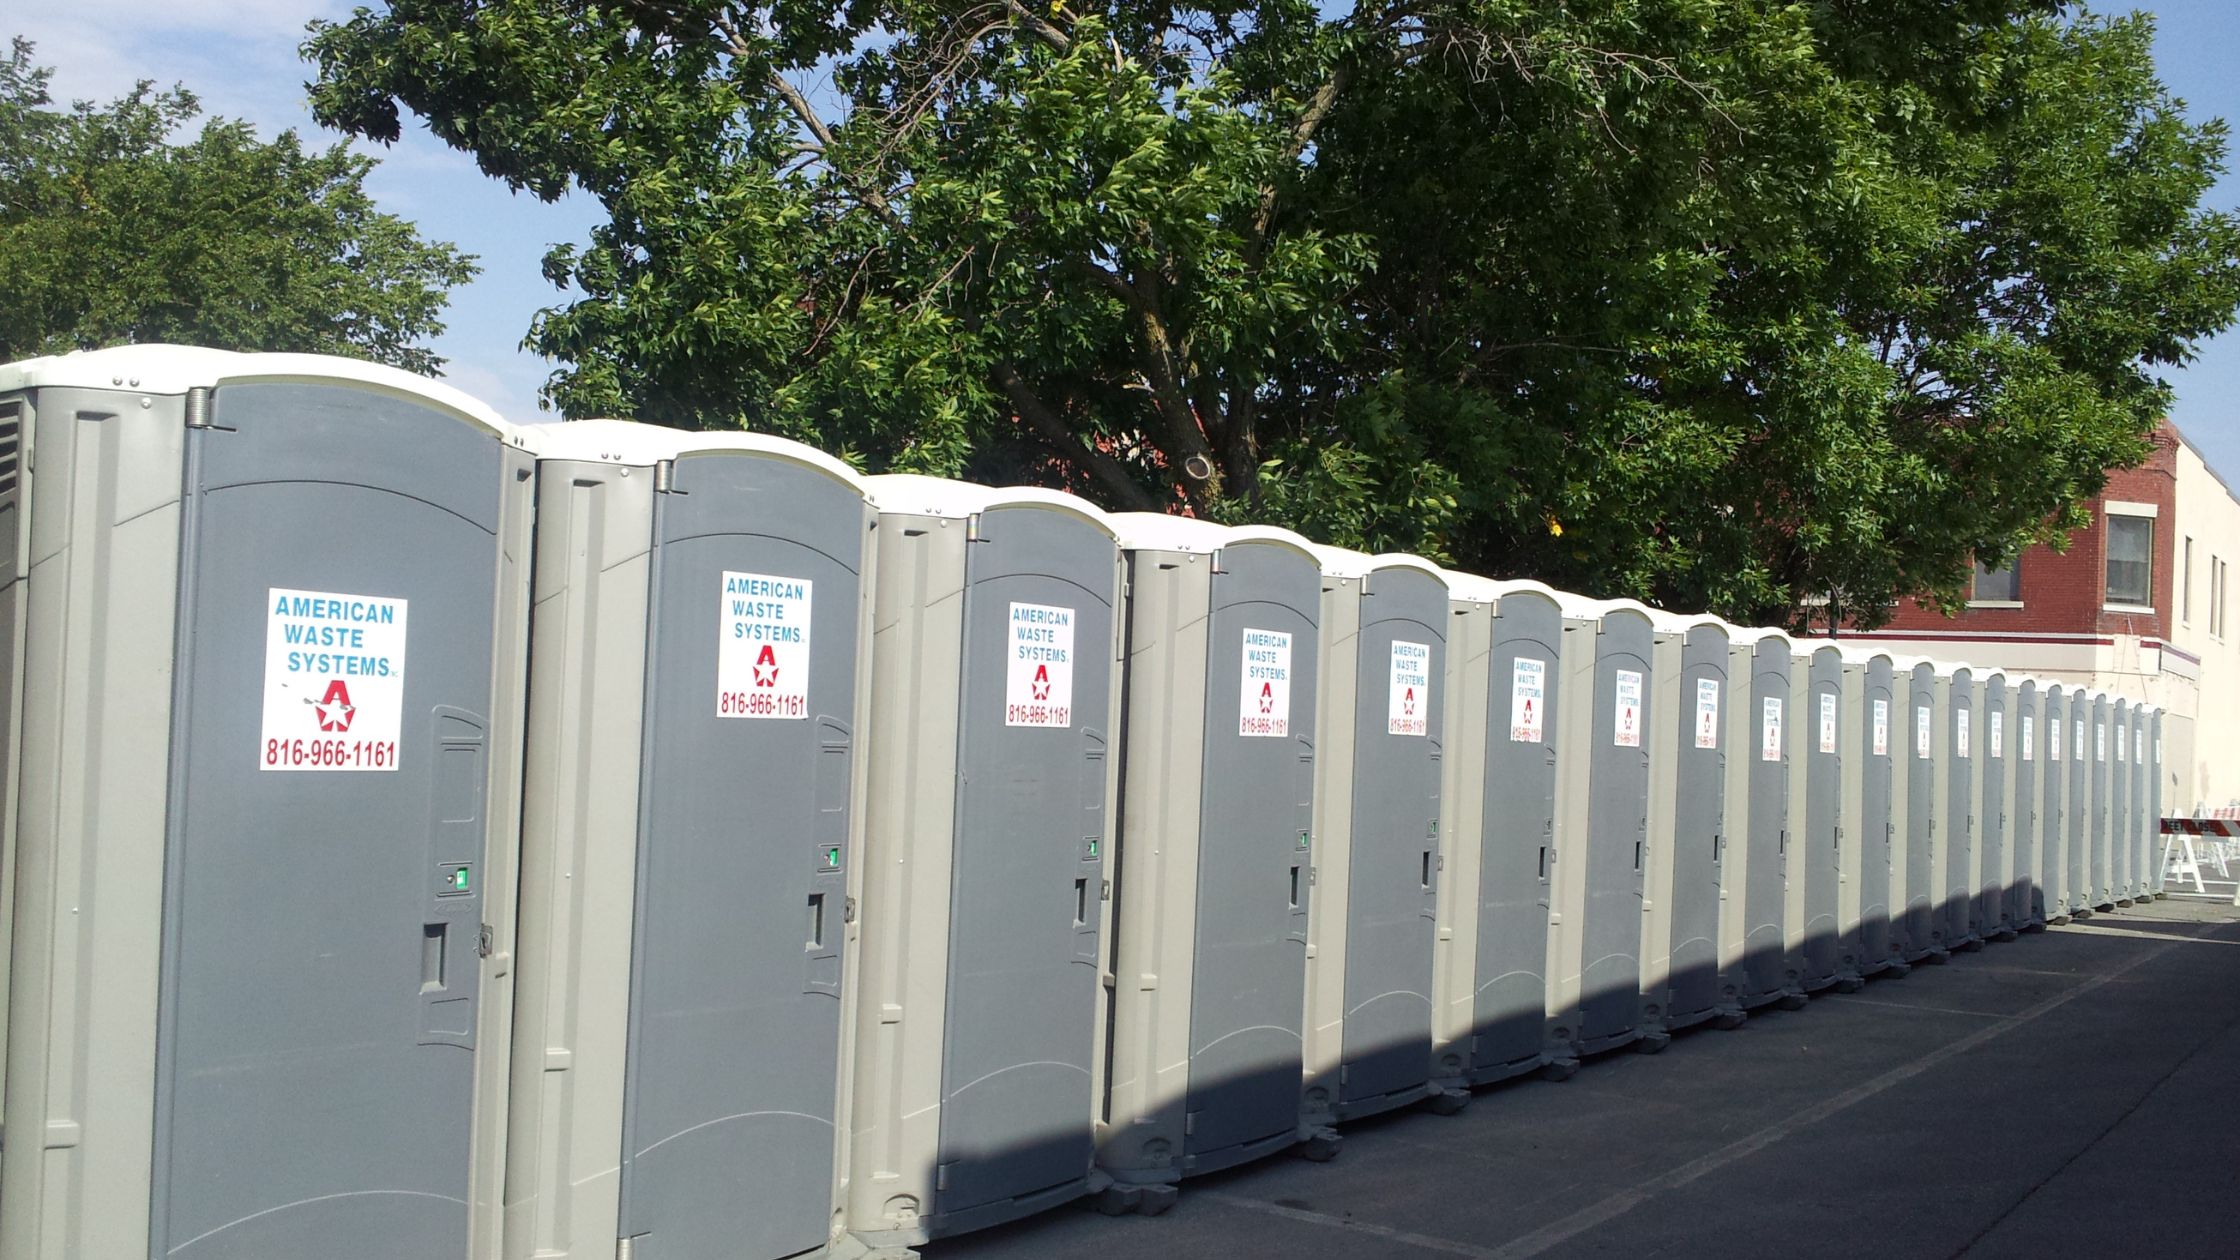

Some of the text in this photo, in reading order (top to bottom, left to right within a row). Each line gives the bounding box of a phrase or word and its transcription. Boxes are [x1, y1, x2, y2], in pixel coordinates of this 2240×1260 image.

[727, 578, 803, 600] AMERICAN
[275, 596, 393, 624] AMERICAN
[732, 600, 784, 620] WASTE
[1013, 608, 1068, 626] AMERICAN
[284, 624, 363, 648] WASTE
[735, 622, 801, 643] SYSTEMS
[1017, 626, 1054, 643] WASTE
[1245, 633, 1287, 648] AMERICAN
[1018, 646, 1066, 663] SYSTEMS
[1248, 650, 1276, 663] WASTE
[1393, 645, 1426, 658] AMERICAN
[288, 651, 390, 677] SYSTEMS
[1250, 666, 1286, 680] SYSTEMS
[1396, 659, 1418, 671] WASTE
[1396, 673, 1425, 686] SYSTEMS
[721, 692, 804, 715] 816-966-1161
[1009, 704, 1068, 725] 816-966-1161
[1241, 717, 1287, 734] 816-966-1161
[266, 738, 394, 767] 816-966-1161
